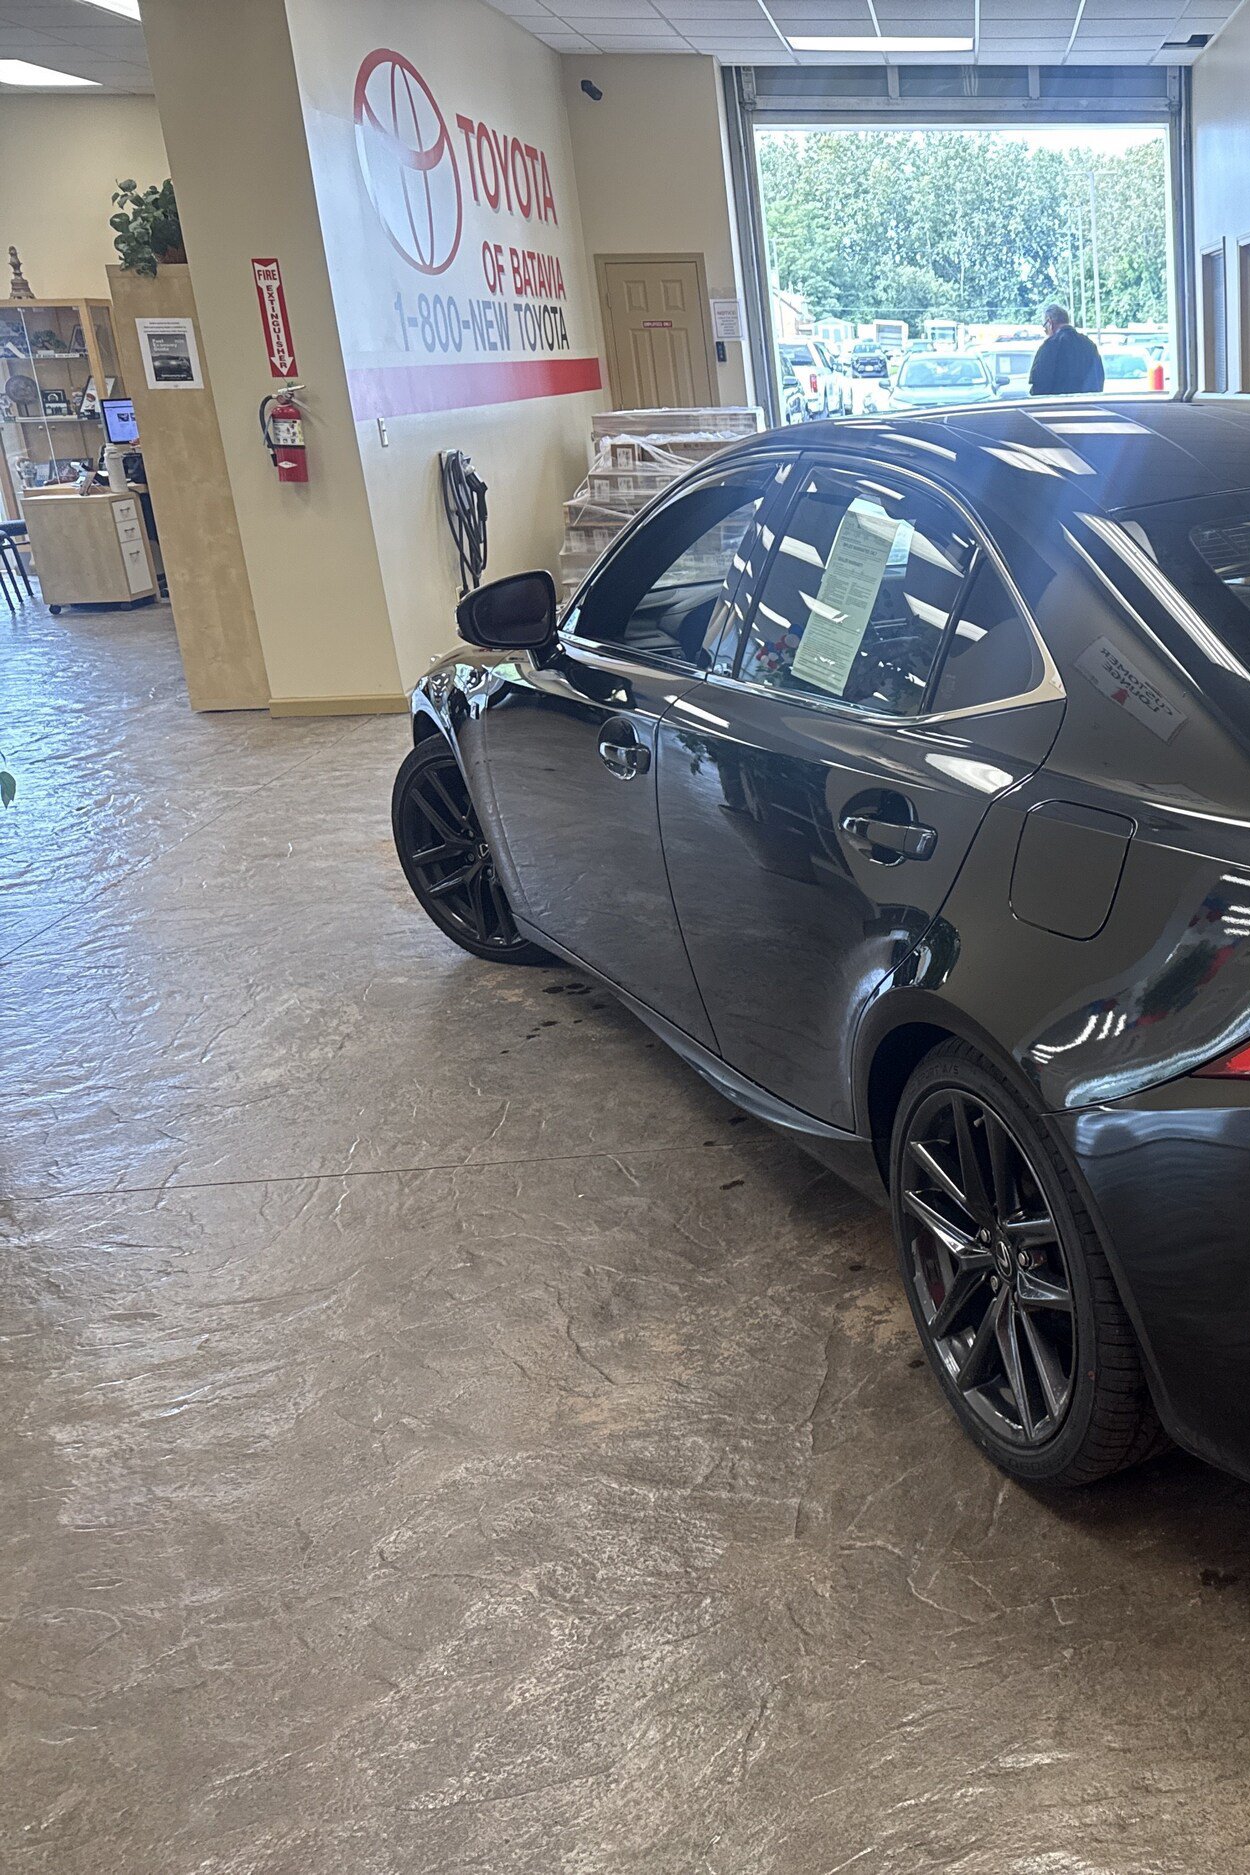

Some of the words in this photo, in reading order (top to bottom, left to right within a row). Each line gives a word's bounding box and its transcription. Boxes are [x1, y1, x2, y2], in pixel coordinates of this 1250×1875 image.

[455, 112, 559, 226] TOYOTA
[256, 269, 278, 281] FIRE
[481, 240, 505, 295] OF
[509, 246, 567, 301] BATAVIA
[265, 284, 288, 369] EXTINGUISHER
[394, 291, 511, 353] 1-800-NEW
[513, 302, 571, 352] TOYOTA
